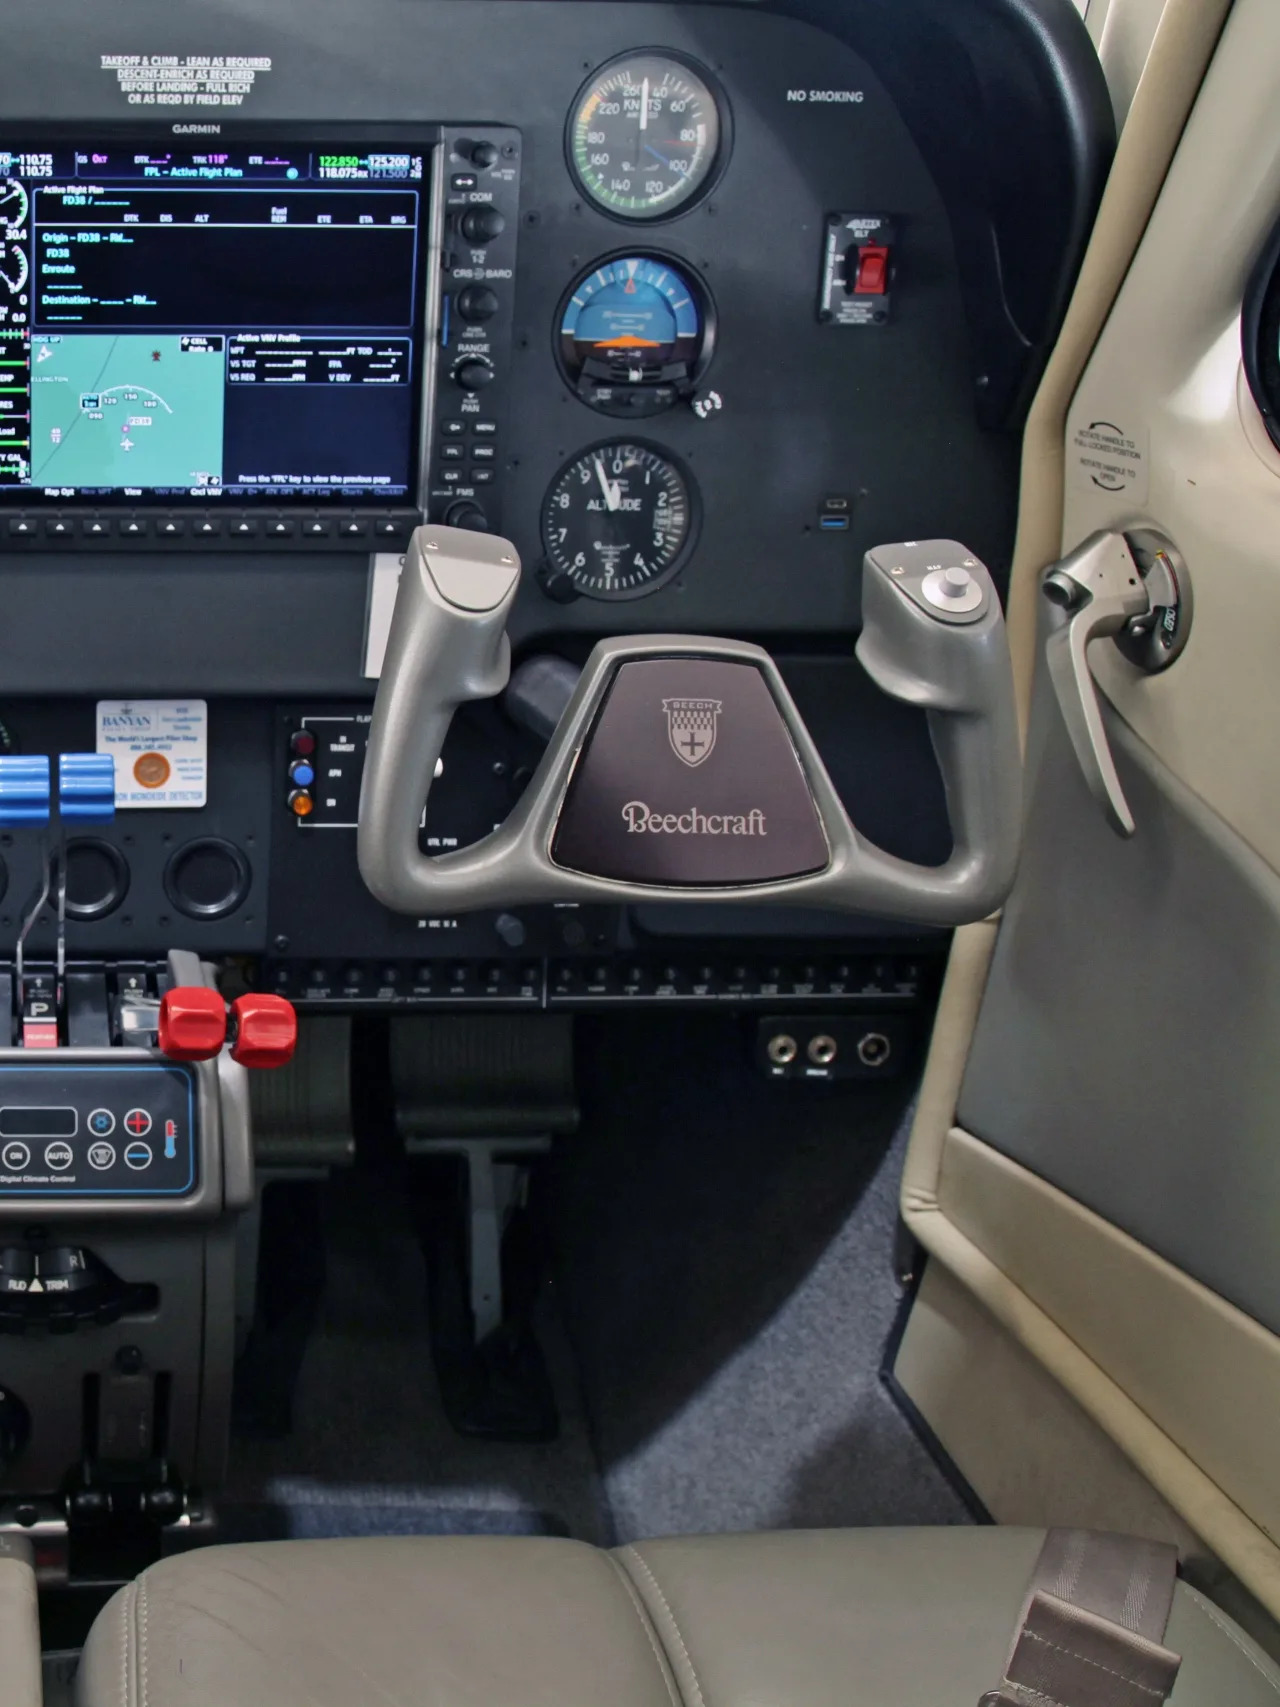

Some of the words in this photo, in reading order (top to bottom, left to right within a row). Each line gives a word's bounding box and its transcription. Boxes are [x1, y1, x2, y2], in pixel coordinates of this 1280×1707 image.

[101, 56, 140, 66] TAKEOFF
[142, 56, 149, 65] &
[151, 56, 178, 66] CLIMB
[187, 57, 210, 67] LEAN
[212, 57, 224, 67] AS
[226, 57, 271, 67] REQUIRED
[118, 69, 193, 79] DESCENT-ENRICH
[196, 70, 208, 79] AS
[209, 70, 255, 80] REQUIRED
[121, 82, 154, 92] BEFORE
[156, 82, 198, 92] LANDING
[206, 83, 227, 93] FULL
[228, 83, 251, 93] RICH
[652, 87, 668, 98] 40
[128, 94, 141, 104] OR
[143, 94, 155, 104] AS
[157, 94, 182, 104] REQD
[184, 95, 194, 104] BY
[196, 95, 220, 105] FIELD
[222, 95, 243, 105] ELEV
[787, 90, 806, 101] NO
[809, 90, 864, 102] SMOKING
[599, 103, 620, 115] 220
[670, 101, 685, 112] 60
[172, 124, 220, 134] GARMIN
[588, 132, 605, 143] 180
[680, 129, 695, 141] 80
[20, 154, 53, 165] 110.75
[320, 156, 358, 166] 122.850
[370, 156, 408, 166] 125.200
[591, 153, 609, 165] 160
[20, 166, 53, 176] 110.75
[670, 160, 688, 171] 100
[145, 167, 160, 176] FPL
[171, 168, 198, 177] Active
[200, 168, 224, 179] Flight
[226, 168, 243, 177] Plan
[43, 186, 66, 194] Active
[68, 186, 87, 195] Flight
[88, 186, 104, 194] Plan
[611, 179, 631, 191] 140
[646, 181, 663, 193] 120
[63, 196, 86, 205] FD38
[470, 193, 492, 201] COM
[5, 229, 27, 240] 30.4
[42, 233, 68, 244] Origin
[77, 233, 100, 242] FD38
[46, 249, 70, 258] FD38
[42, 264, 75, 274] Enroute
[486, 269, 512, 278] BARO
[42, 295, 91, 305] Destination
[458, 344, 490, 352] RANGE
[461, 404, 480, 412] PAN
[612, 460, 623, 474] 0
[239, 475, 257, 483] Press
[258, 475, 270, 483] the
[289, 476, 302, 484] key
[312, 475, 329, 483] view
[330, 475, 342, 483] the
[343, 475, 372, 484] previous
[580, 470, 591, 484] 9
[559, 493, 570, 508] 8
[658, 492, 668, 507] 2
[558, 528, 568, 543] 7
[653, 532, 664, 546] 3
[575, 552, 586, 566] 6
[634, 553, 645, 566] 4
[604, 563, 614, 577] 5
[102, 716, 151, 727] BANYAN
[622, 801, 767, 836] Beechcraft
[30, 1002, 49, 1017] P
[10, 1151, 23, 1160] ON
[47, 1151, 70, 1160] AUTO
[0, 1175, 21, 1184] Digital
[23, 1174, 49, 1183] Climate
[50, 1174, 76, 1183] Control
[9, 1280, 27, 1291] RUD
[45, 1280, 69, 1290] TRIM
